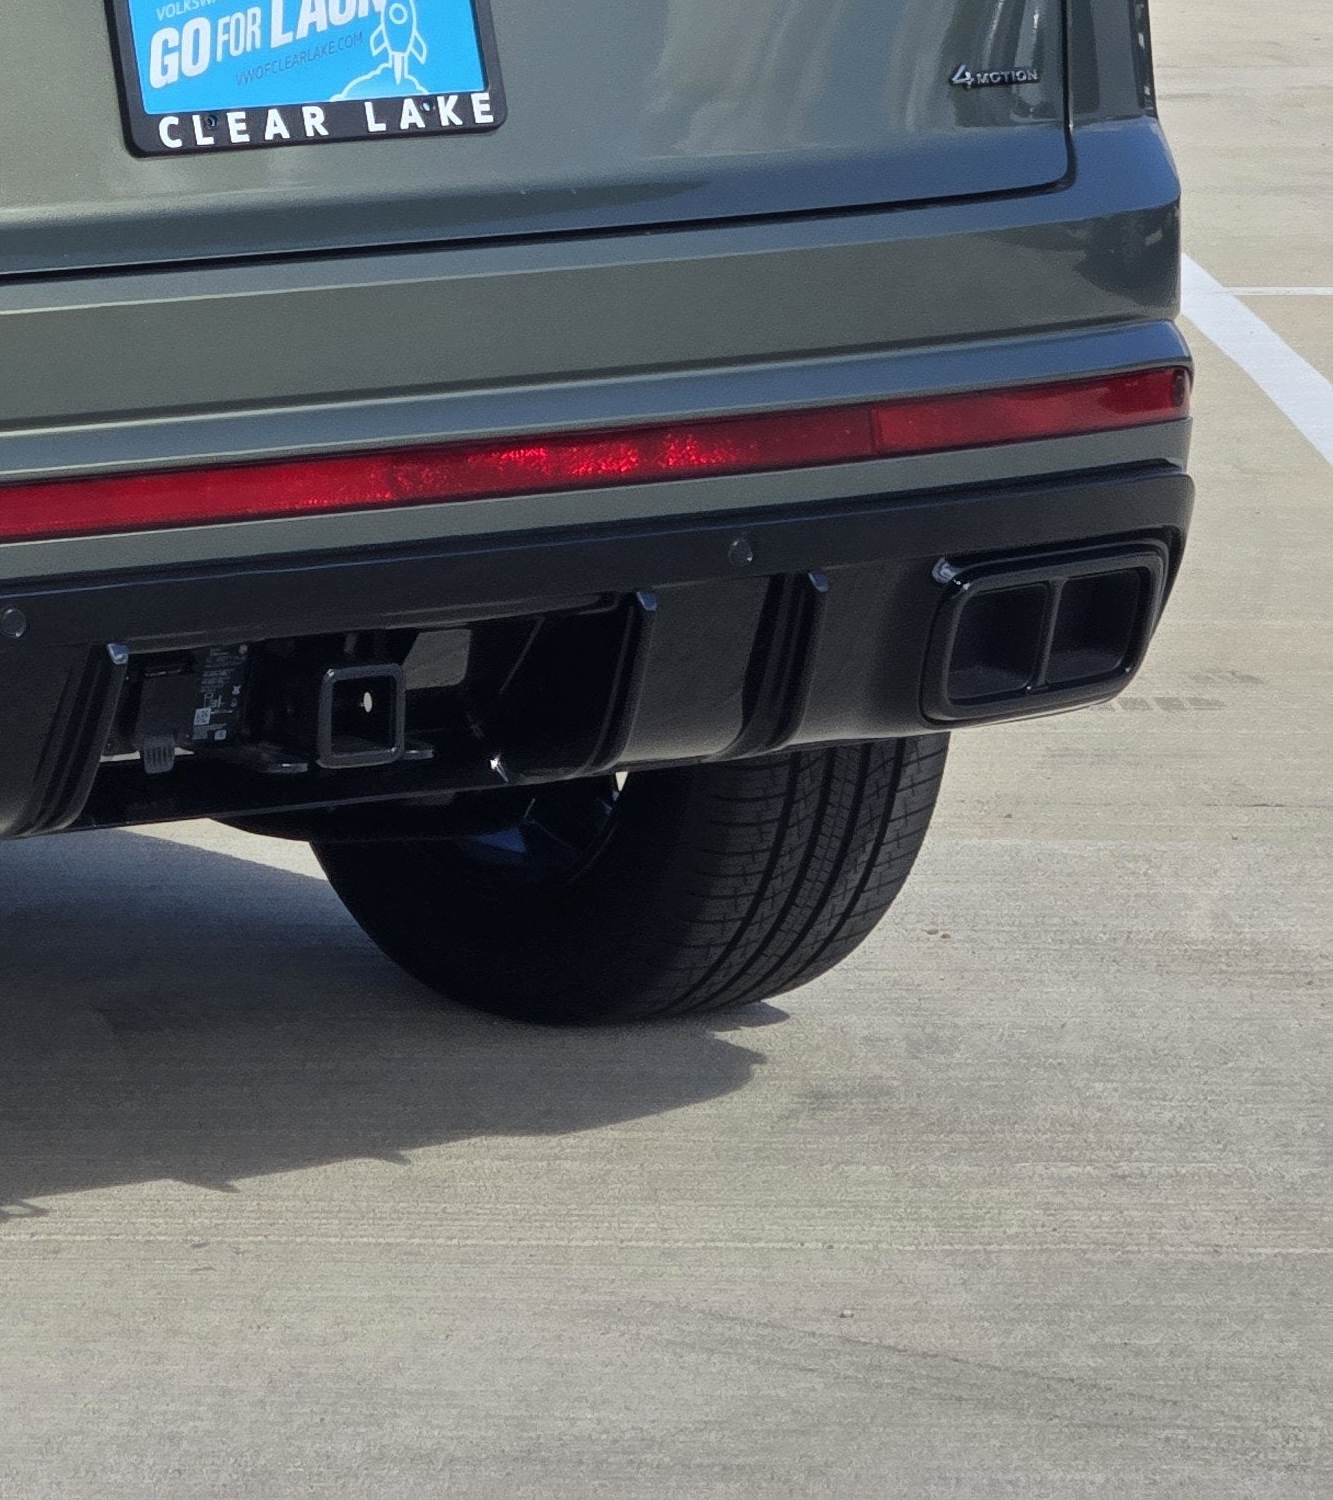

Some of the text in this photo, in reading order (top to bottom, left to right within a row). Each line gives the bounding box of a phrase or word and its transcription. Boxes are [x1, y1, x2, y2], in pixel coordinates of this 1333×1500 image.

[149, 16, 212, 89] GO
[216, 6, 262, 63] FOR
[158, 92, 495, 149] CLEAR LAKE
